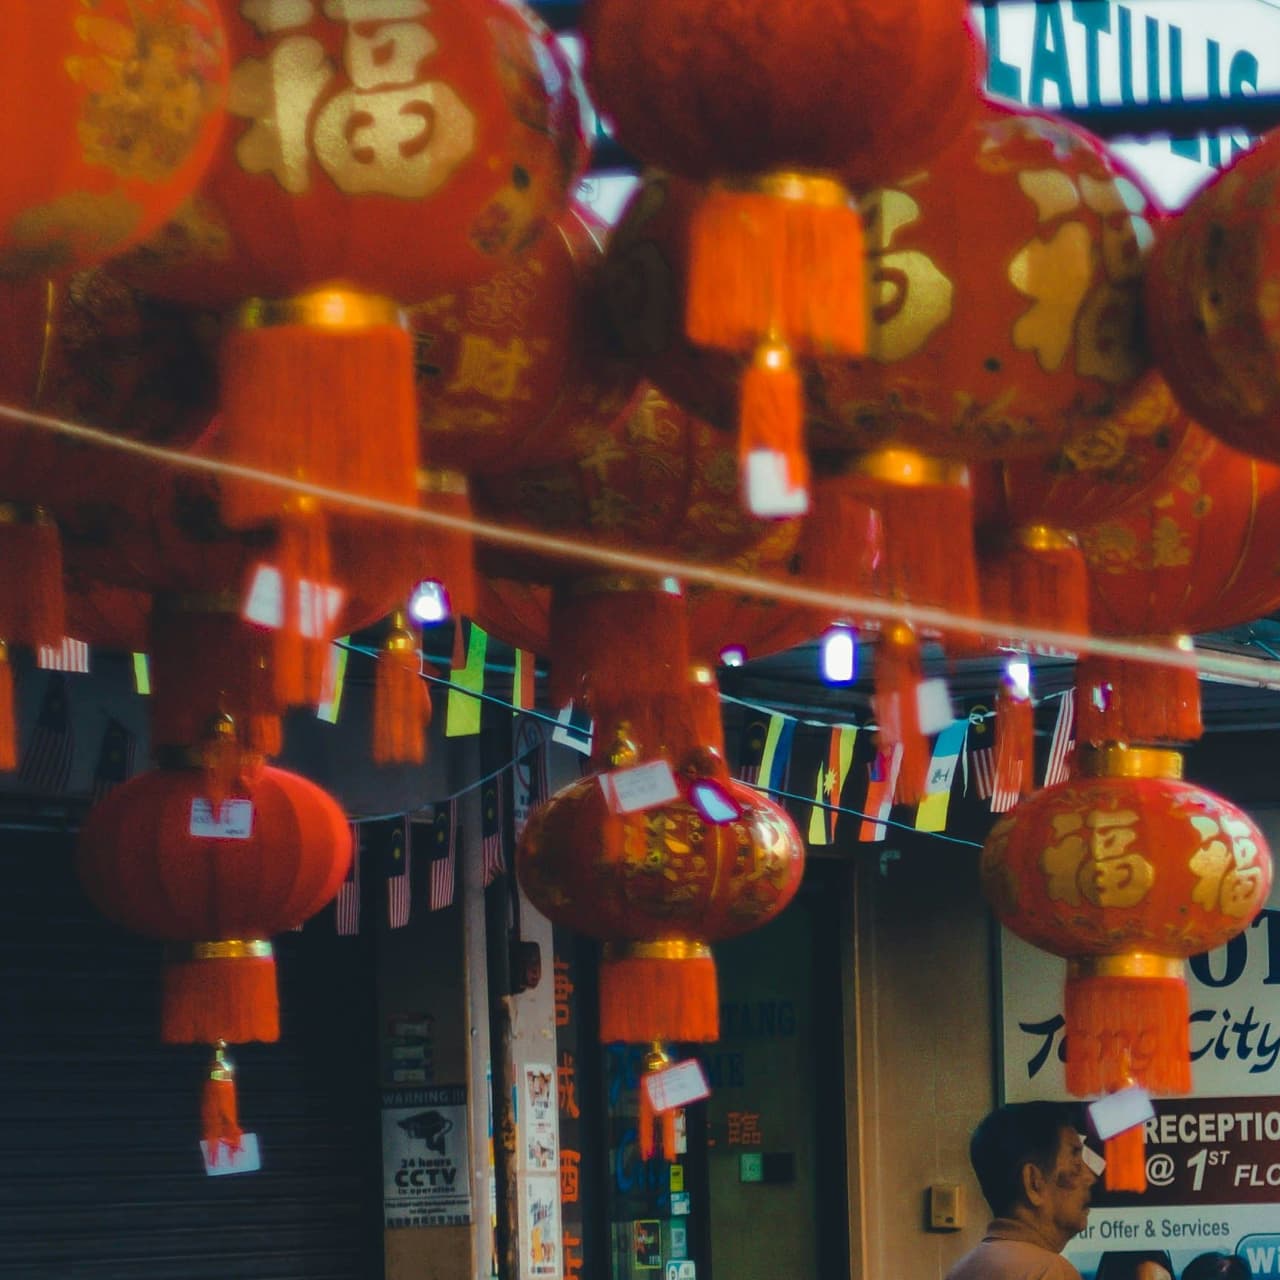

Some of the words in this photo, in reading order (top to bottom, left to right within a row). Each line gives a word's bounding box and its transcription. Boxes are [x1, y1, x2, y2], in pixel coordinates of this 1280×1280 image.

[1041, 810, 1153, 907] 福
[394, 1168, 457, 1187] CCTV
[1100, 1219, 1139, 1238] Offer
[1145, 1219, 1156, 1237] &
[1161, 1218, 1230, 1237] Services
